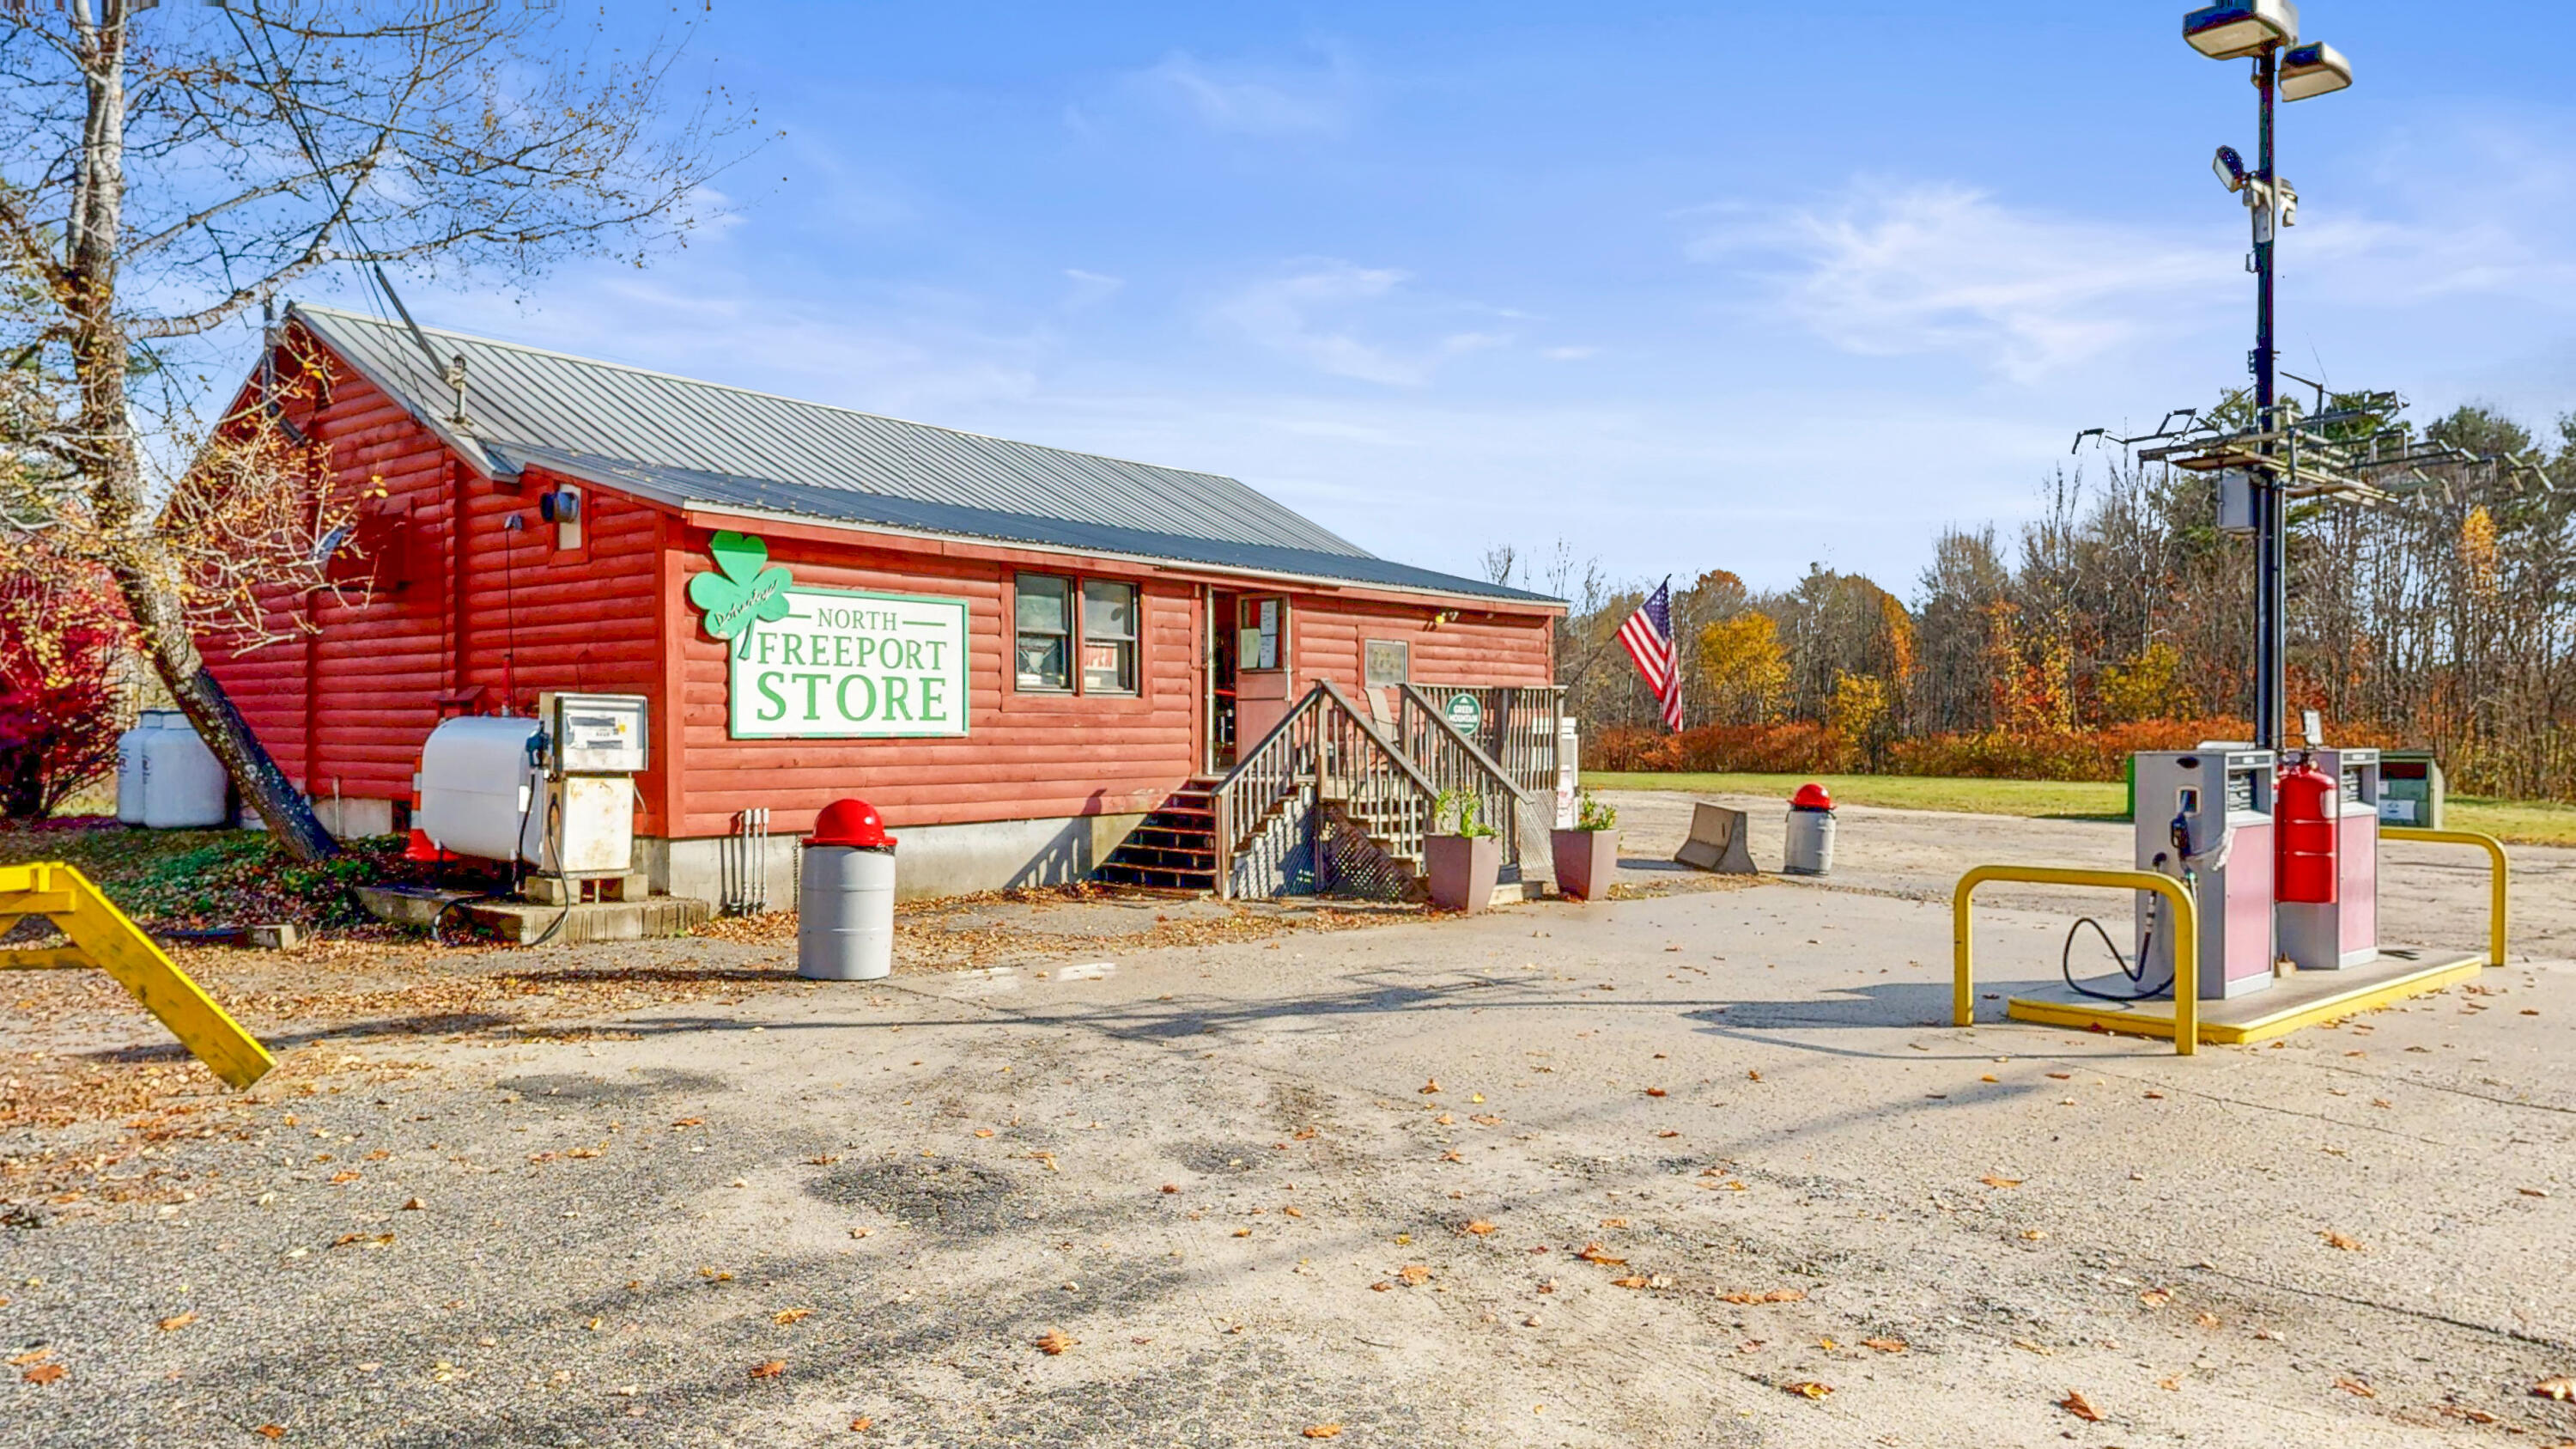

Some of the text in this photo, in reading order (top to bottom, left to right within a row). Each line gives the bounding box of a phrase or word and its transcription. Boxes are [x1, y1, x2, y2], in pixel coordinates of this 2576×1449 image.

[817, 608, 897, 630] NORTH
[756, 632, 947, 670] FREEPORT
[756, 671, 947, 721] STORE
